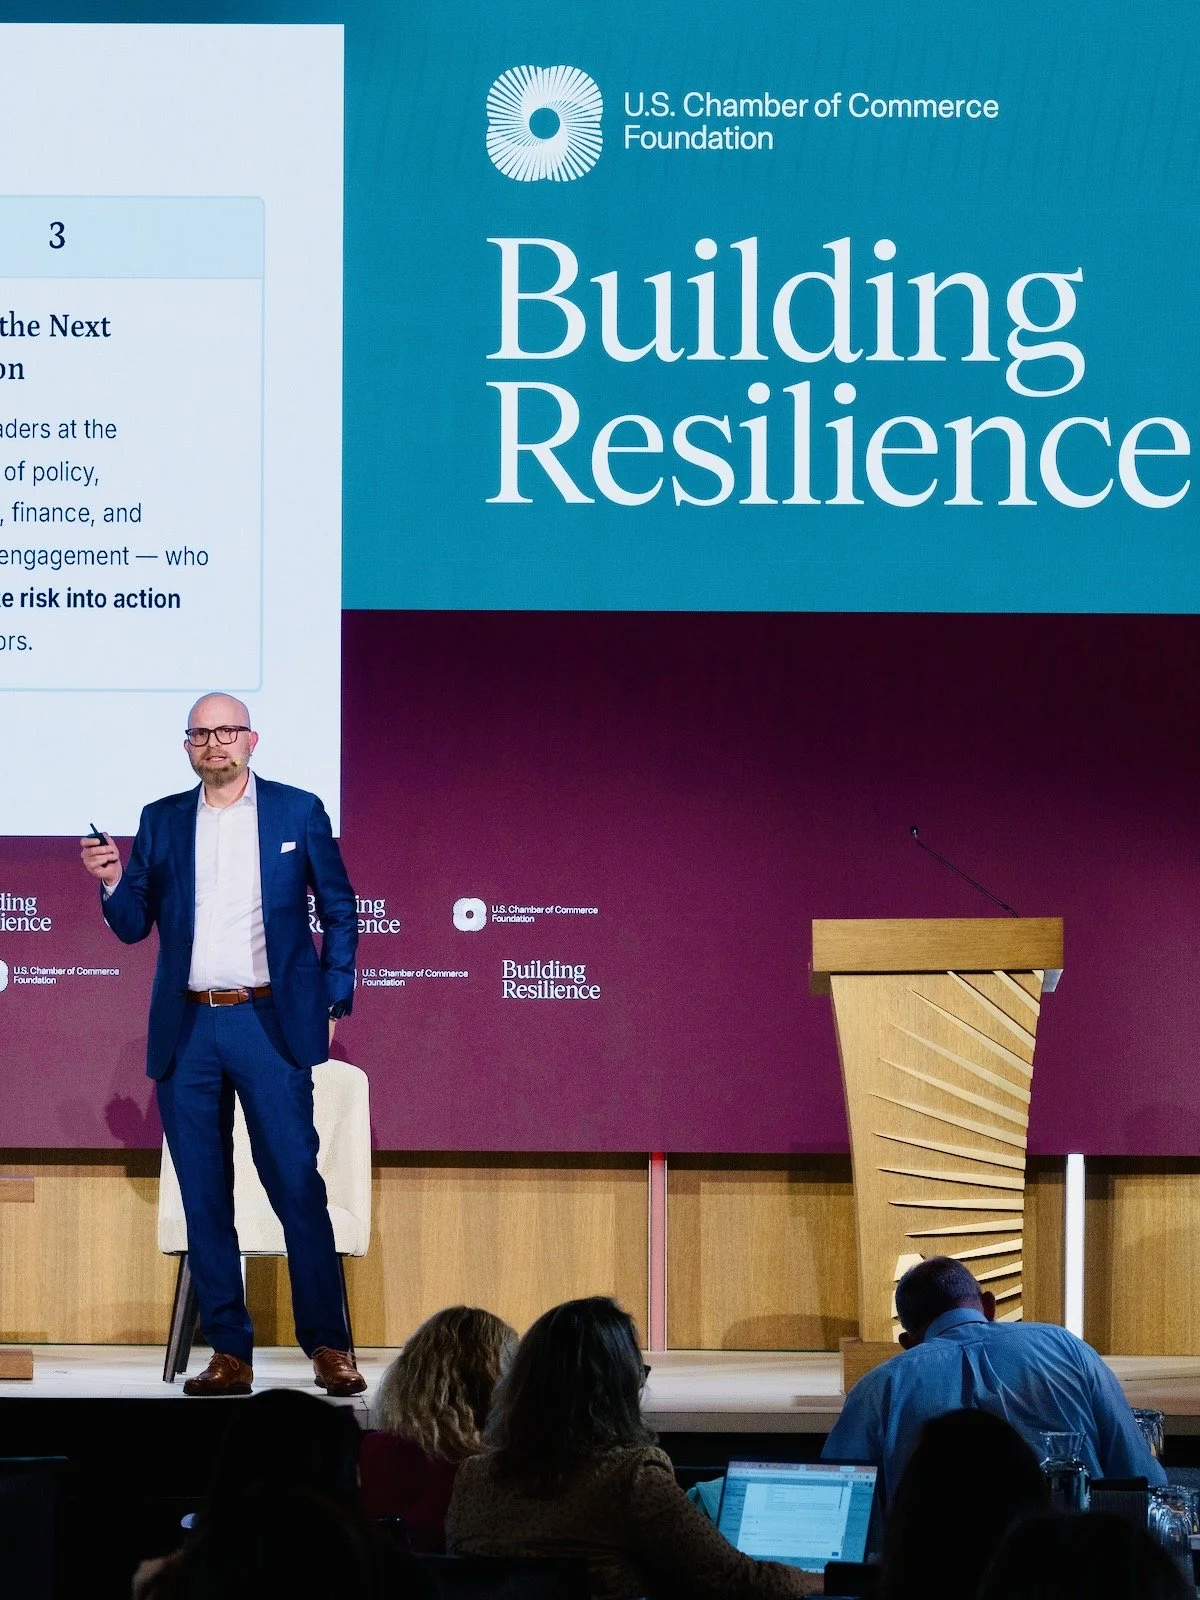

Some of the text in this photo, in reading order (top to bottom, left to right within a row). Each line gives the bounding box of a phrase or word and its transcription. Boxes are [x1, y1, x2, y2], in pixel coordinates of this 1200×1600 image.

[624, 91, 1000, 119] U.S. Chamber of Commerce
[624, 124, 774, 150] Foundation
[49, 221, 66, 250] 3
[49, 314, 112, 338] Next
[485, 236, 1086, 398] Building
[58, 419, 78, 439] at
[83, 418, 117, 439] the
[485, 380, 1191, 509] Resilience
[4, 460, 26, 482] of
[33, 460, 99, 487] policy,
[11, 501, 95, 528] finance,
[103, 502, 142, 523] and
[165, 545, 209, 566] who
[20, 586, 61, 608] risk
[66, 586, 107, 609] into
[113, 586, 181, 609] action
[306, 894, 386, 918] Bing
[491, 904, 598, 915] U.S. Chamber of Commerce
[308, 914, 400, 933] Rence
[492, 914, 535, 923] Foundation
[361, 968, 468, 979] U.S. Chamber of Commerce
[362, 978, 405, 987] Foundation
[503, 960, 586, 984] Building
[502, 980, 601, 1000] Resilience
